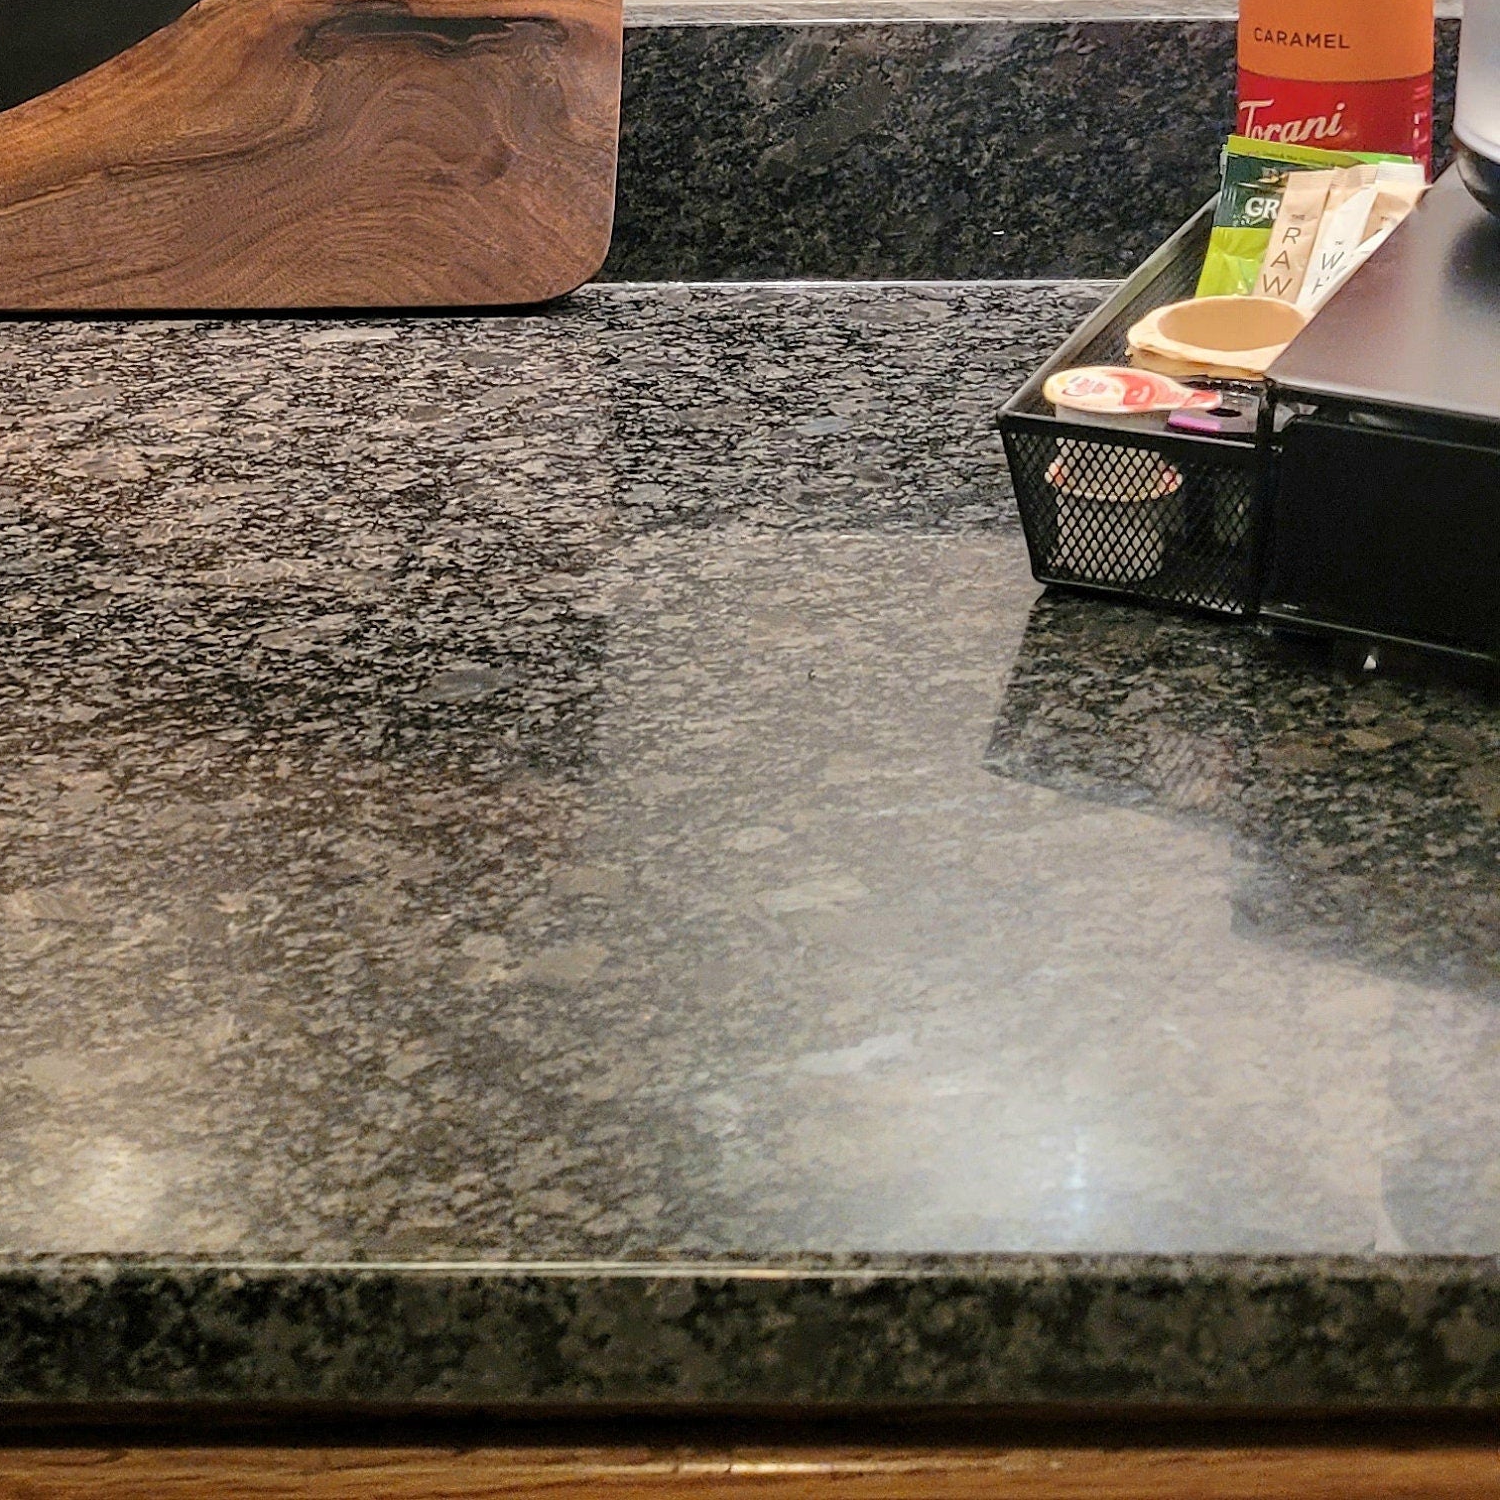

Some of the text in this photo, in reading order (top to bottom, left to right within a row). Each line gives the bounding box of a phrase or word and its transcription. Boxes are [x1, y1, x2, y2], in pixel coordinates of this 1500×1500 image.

[1255, 27, 1350, 49] CARAMEL
[1239, 99, 1346, 143] Torani
[1263, 227, 1302, 296] RAW
